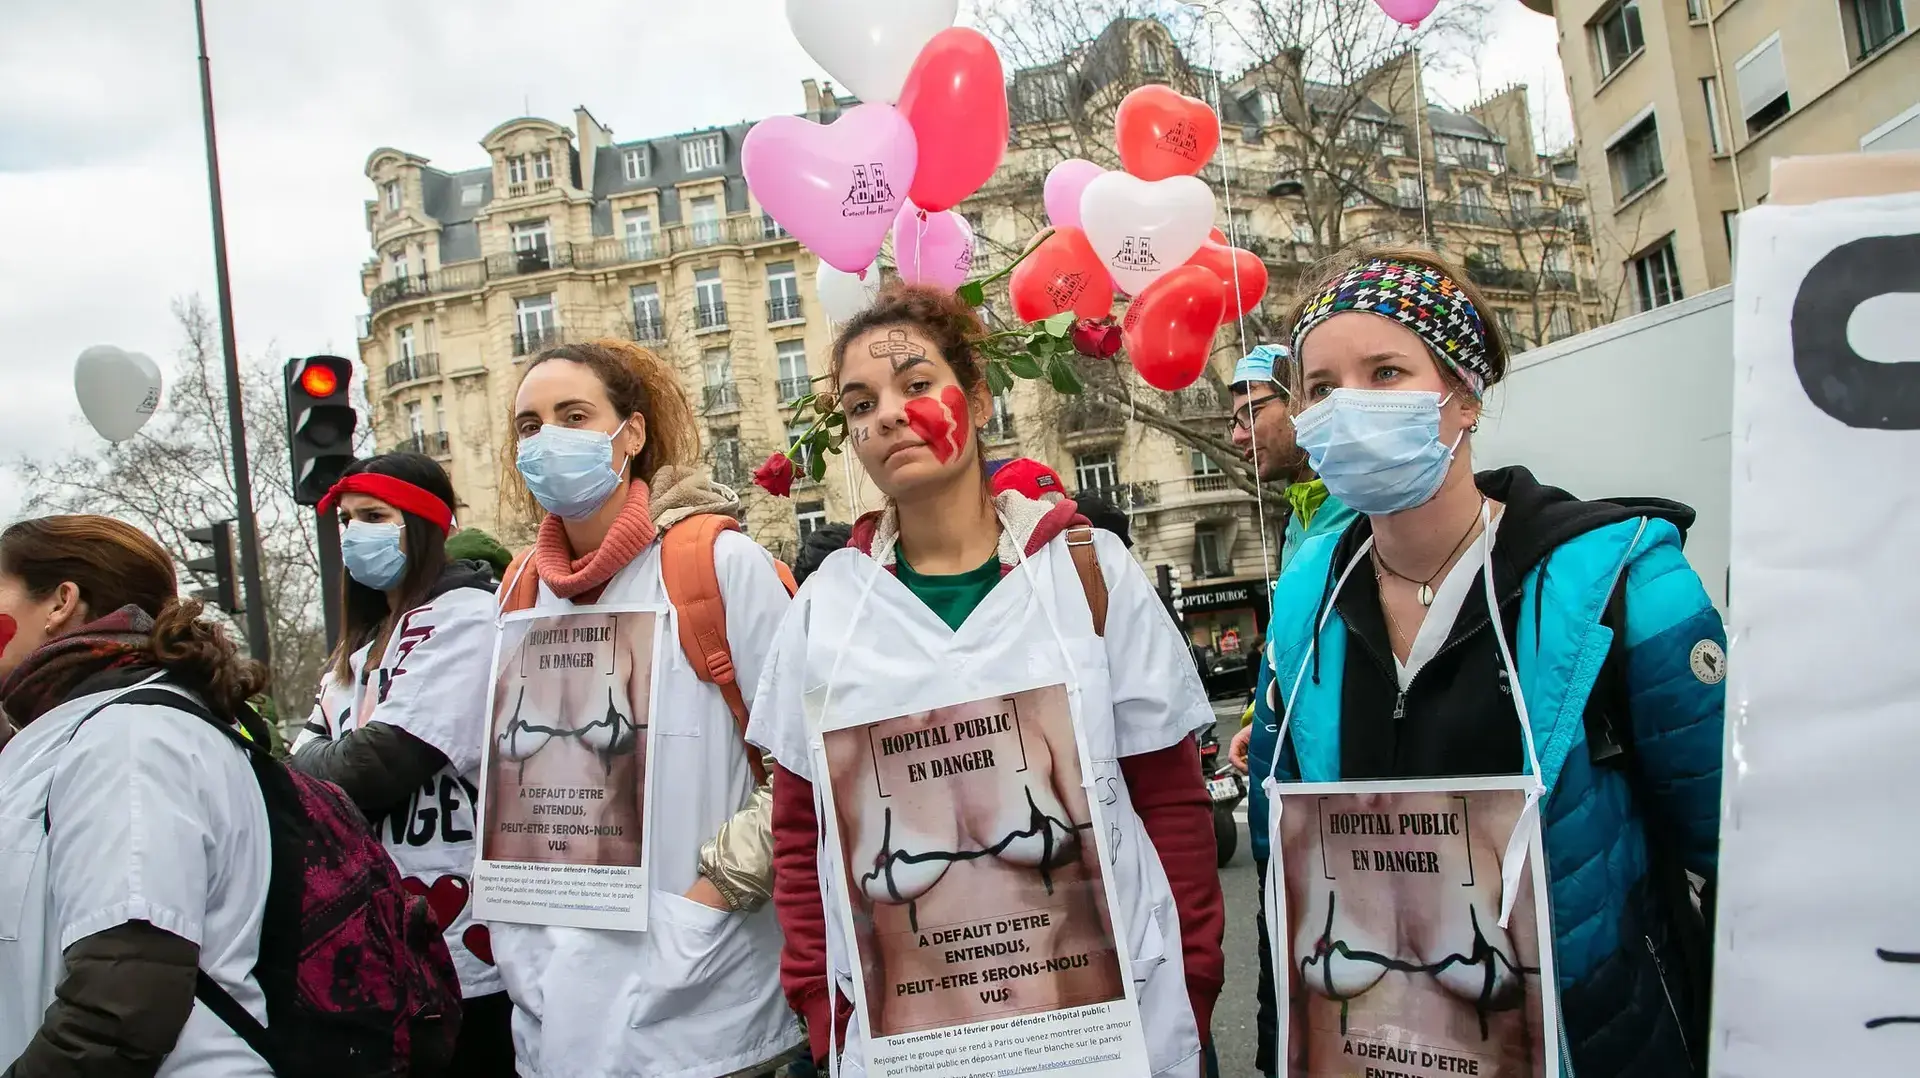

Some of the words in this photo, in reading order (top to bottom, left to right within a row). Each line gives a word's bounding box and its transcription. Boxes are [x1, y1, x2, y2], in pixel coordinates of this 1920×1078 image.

[1182, 594, 1214, 606] OPTIC
[1215, 589, 1247, 602] DUROC
[530, 628, 569, 646] HOPITAL
[572, 626, 611, 643] PUBLIC
[539, 655, 550, 669] EN
[553, 652, 594, 668] DANGER
[881, 725, 950, 757] HOPITAL
[955, 713, 1012, 742] PUBLIC
[907, 764, 927, 783] EN
[932, 748, 995, 779] DANGER
[520, 789, 526, 798] A
[529, 789, 566, 799] DEFAUT
[533, 804, 587, 817] ENTENDUS,
[500, 822, 550, 834] PEUT-ETRE
[552, 824, 623, 836] SERONS-NOUS
[1330, 813, 1394, 835] HOPITAL
[1399, 813, 1460, 836] PUBLIC
[548, 840, 567, 851] VUS
[1353, 850, 1370, 871] EN
[1375, 850, 1439, 873] DANGER
[918, 934, 929, 948] A
[933, 924, 992, 946] DEFAUT
[997, 913, 1050, 935] D'ETRE
[945, 940, 1030, 964] ENTENDUS,
[897, 969, 978, 996] PEUT-ETRE
[982, 954, 1089, 983] SERONS-NOUS
[980, 988, 1009, 1004] VUS
[907, 1033, 942, 1044] ensemble
[953, 1028, 962, 1037] 14
[964, 1025, 988, 1035] février
[990, 1023, 1009, 1032] pour
[1011, 1015, 1046, 1028] défendre
[1082, 1006, 1105, 1019] public
[873, 1054, 908, 1066] Rejoignez
[918, 1049, 944, 1060] groupe
[946, 1046, 957, 1055] qui
[969, 1042, 986, 1051] rend
[995, 1038, 1013, 1046] Paris
[1026, 1034, 1048, 1042] venez
[1050, 1028, 1081, 1038] montrer
[1083, 1025, 1104, 1033] votre
[1106, 1020, 1132, 1030] amour
[1343, 1040, 1353, 1055] A
[1357, 1042, 1417, 1065] DEFAUT
[887, 1067, 903, 1076] pour
[937, 1058, 958, 1069] public
[971, 1052, 1006, 1065] déposant
[1024, 1046, 1042, 1055] fleur
[1044, 1041, 1074, 1052] blanche
[1099, 1034, 1122, 1045] parvis
